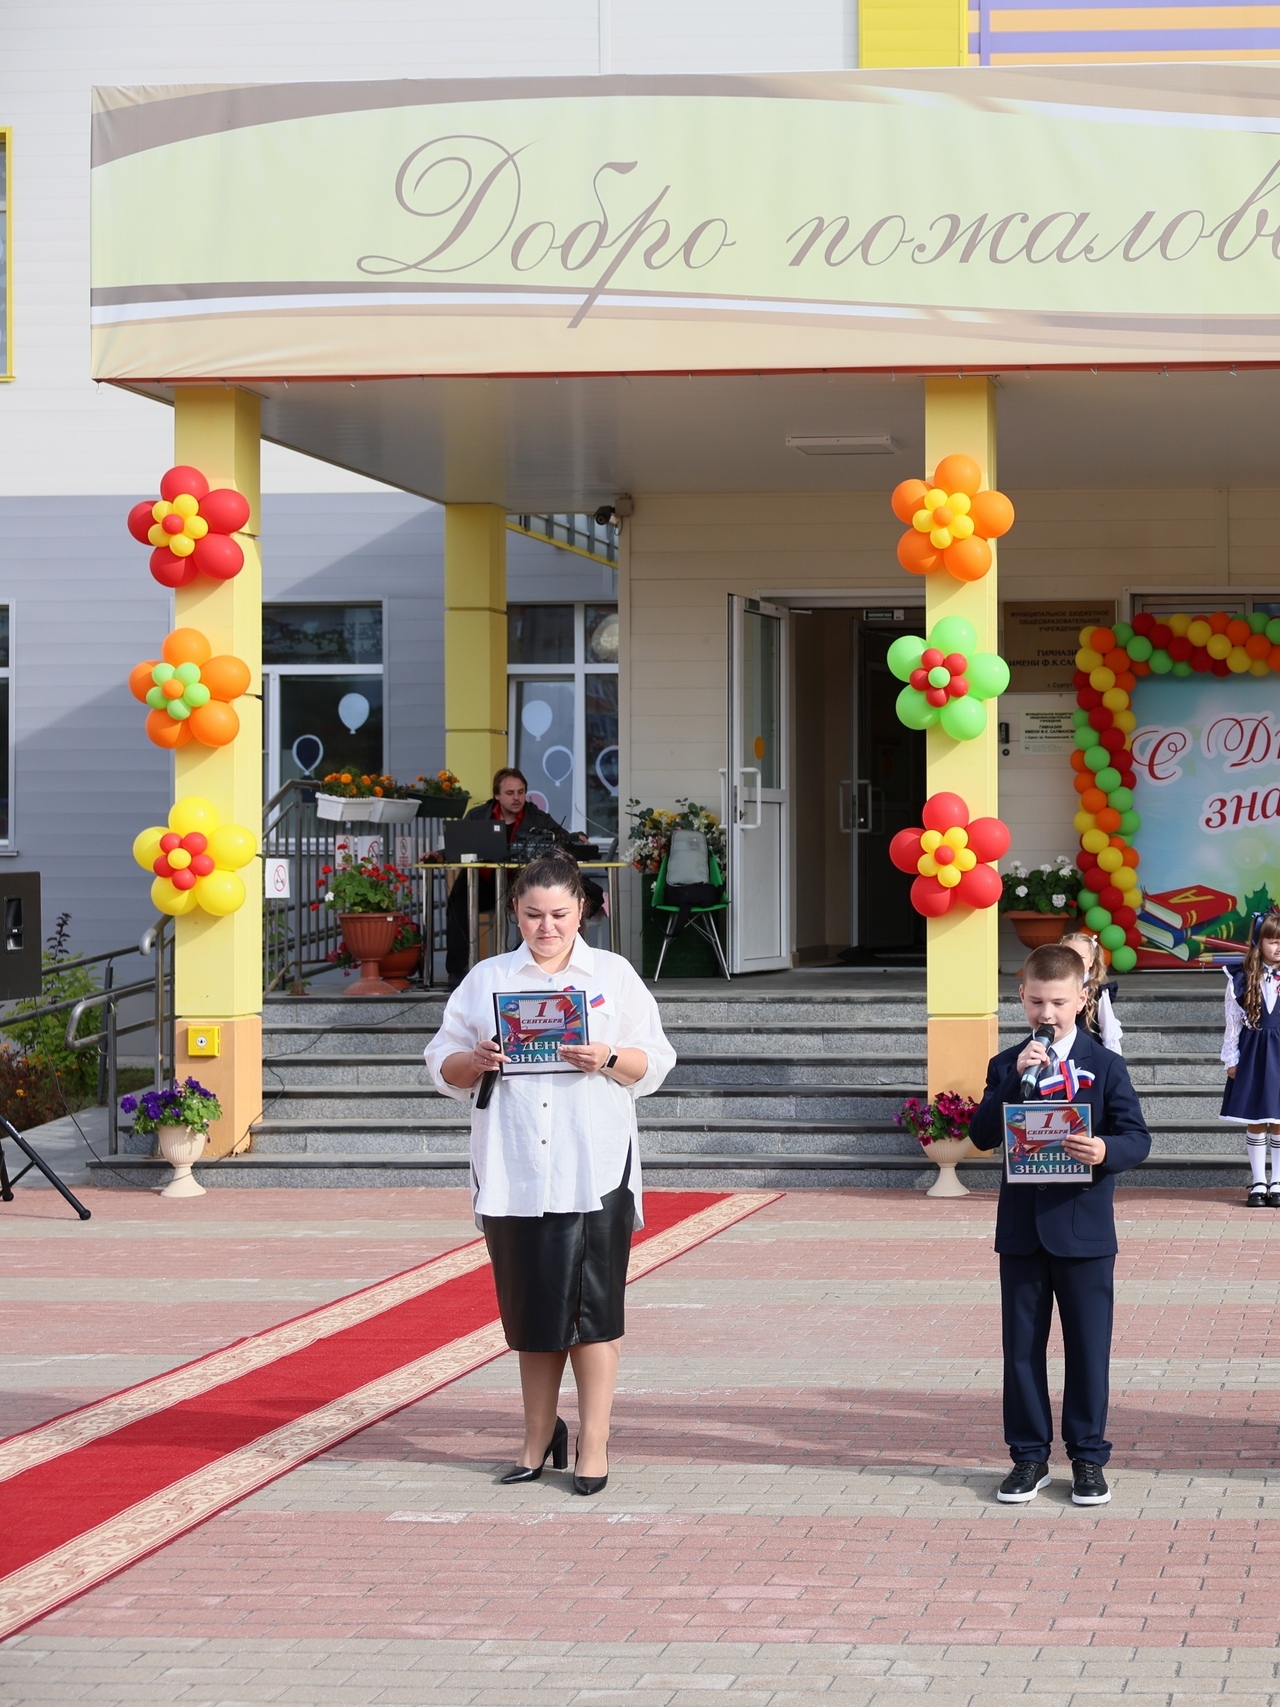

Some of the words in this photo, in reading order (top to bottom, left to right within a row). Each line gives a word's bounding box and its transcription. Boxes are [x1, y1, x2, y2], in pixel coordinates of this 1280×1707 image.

[356, 134, 736, 329] Добро
[1068, 610, 1110, 618] БЮДЖЕТНОЕ
[1019, 617, 1101, 625] ОБЩЕОБРАЗОВАТЕЛЬНОЕ
[1037, 649, 1078, 657] ГИМНАЗИ
[1009, 659, 1039, 667] ИМЕНИ
[1131, 726, 1189, 782] С
[534, 1001, 547, 1017] 1
[510, 1053, 563, 1064] ЗНАН
[1040, 1112, 1054, 1128] 1
[1027, 1152, 1072, 1163] ДЕНЬ
[1015, 1162, 1085, 1174] ЗНАНИЙ
